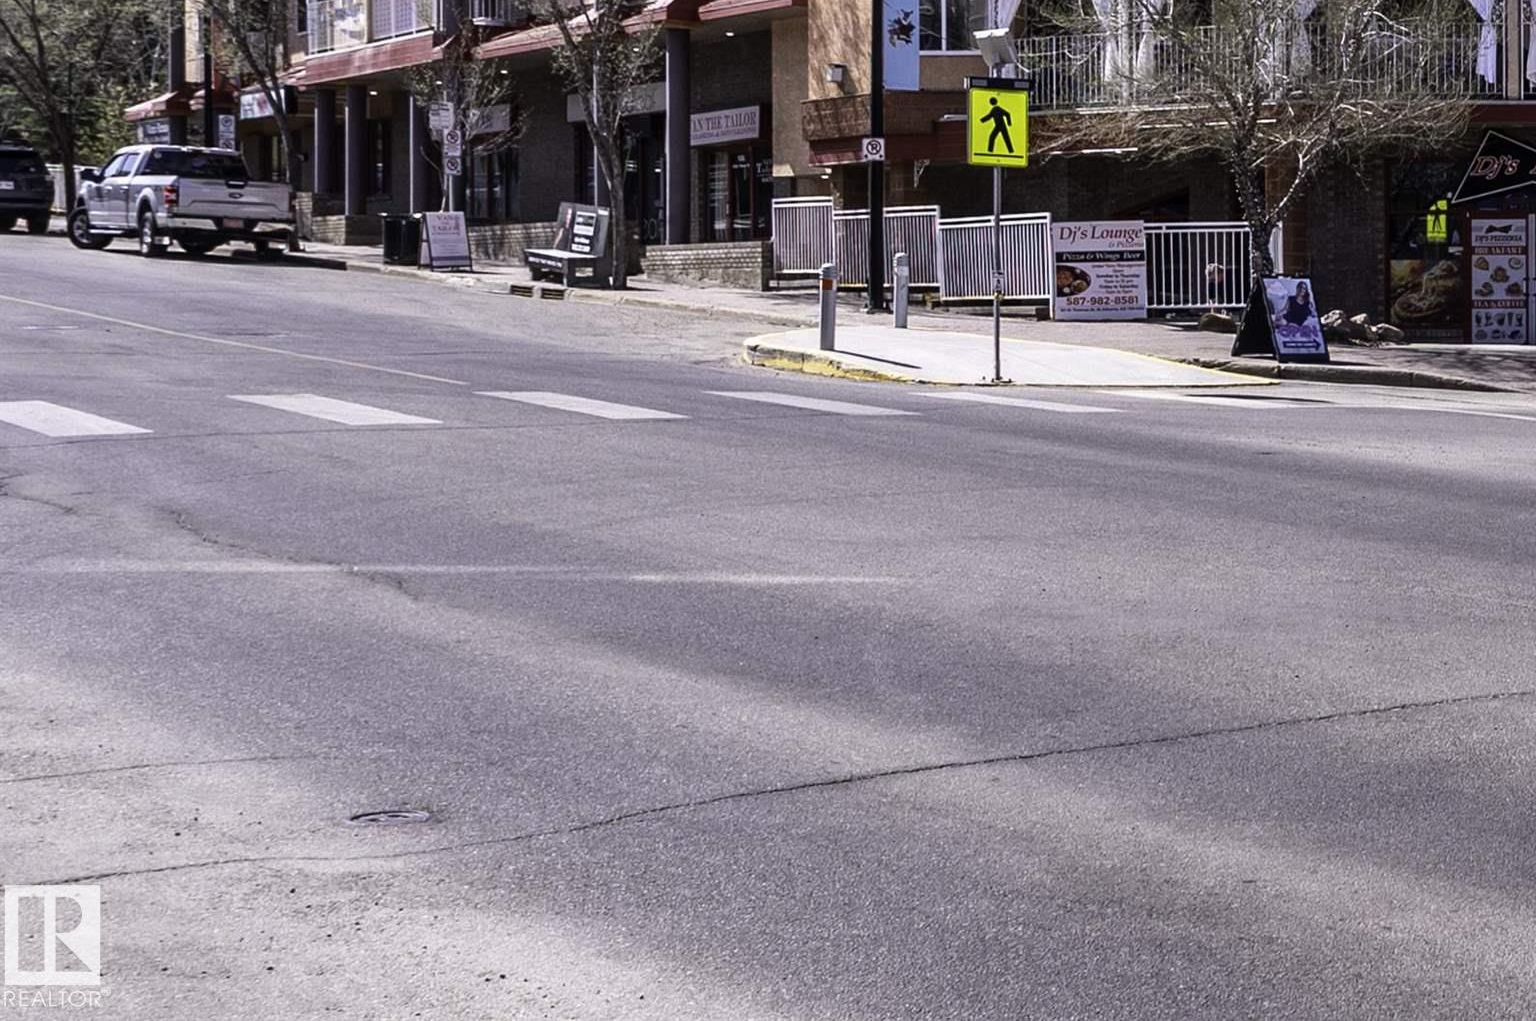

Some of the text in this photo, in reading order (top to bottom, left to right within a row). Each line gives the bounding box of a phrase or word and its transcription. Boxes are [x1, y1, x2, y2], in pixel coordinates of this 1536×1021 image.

[705, 115, 722, 131] THE
[723, 111, 757, 129] TAILOR
[1470, 154, 1521, 180] Dj's
[1060, 225, 1143, 244] Dj's Lounge
[1062, 253, 1085, 261] Pizza
[1095, 253, 1120, 261] Wings
[1066, 296, 1139, 306] 587-982-8581
